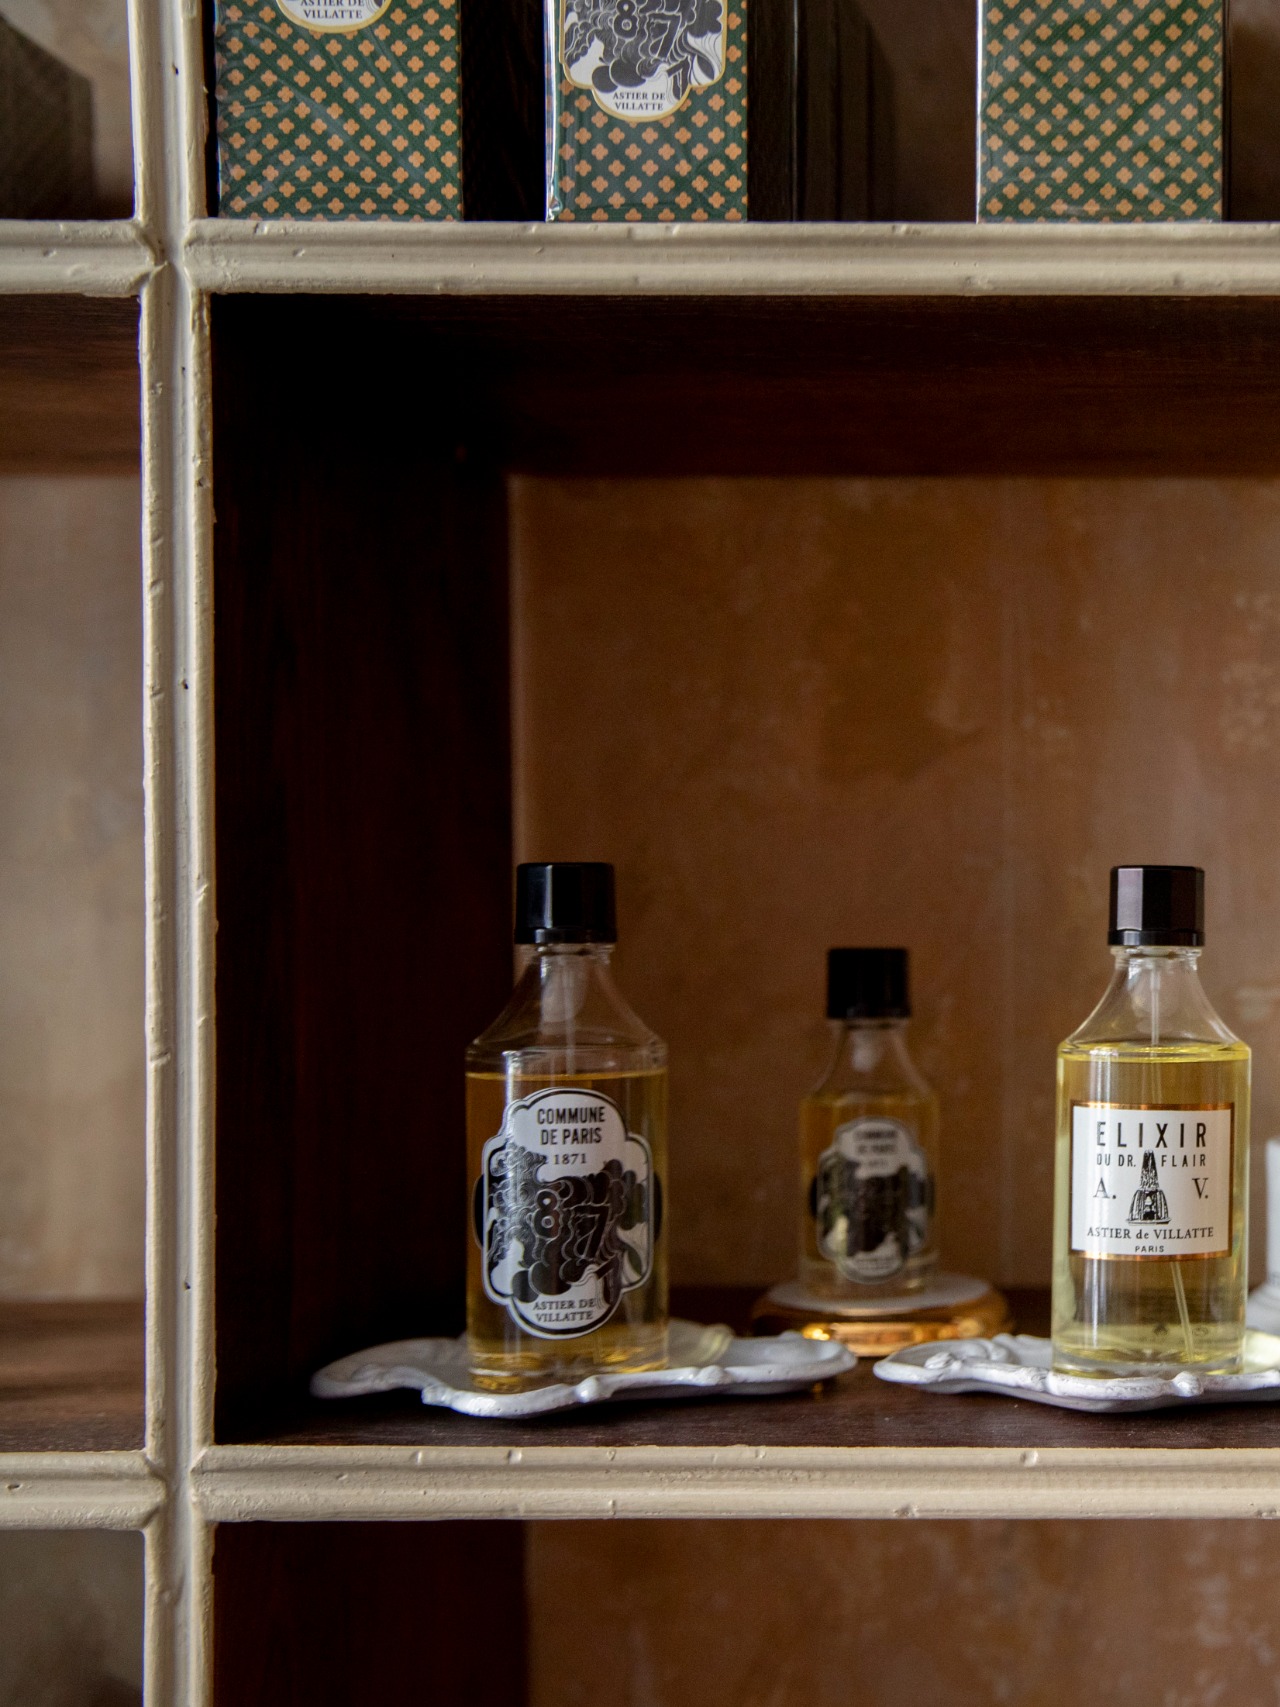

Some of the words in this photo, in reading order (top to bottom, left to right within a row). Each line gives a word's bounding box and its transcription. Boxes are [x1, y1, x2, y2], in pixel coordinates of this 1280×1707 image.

[303, 10, 363, 19] VILLATTE
[612, 92, 648, 101] ASTIER
[651, 92, 666, 101] DE
[615, 102, 664, 111] VILLATTE
[537, 1106, 606, 1125] COMMUNE
[541, 1129, 558, 1145] DE
[562, 1127, 602, 1145] PARIS
[1096, 1121, 1207, 1148] ELIXIR
[554, 1153, 587, 1165] 1871
[1118, 1154, 1136, 1167] DR.
[1161, 1154, 1206, 1167] FLAIR
[1093, 1177, 1117, 1200] A.
[1192, 1177, 1209, 1200] V.
[1087, 1227, 1131, 1240] ASTIER
[1136, 1228, 1149, 1240] de
[1153, 1227, 1214, 1240] VILLATTE
[1135, 1245, 1165, 1253] PARIS
[532, 1299, 576, 1311] ASTIER
[578, 1298, 596, 1309] DE
[535, 1310, 594, 1323] VILLATTE
